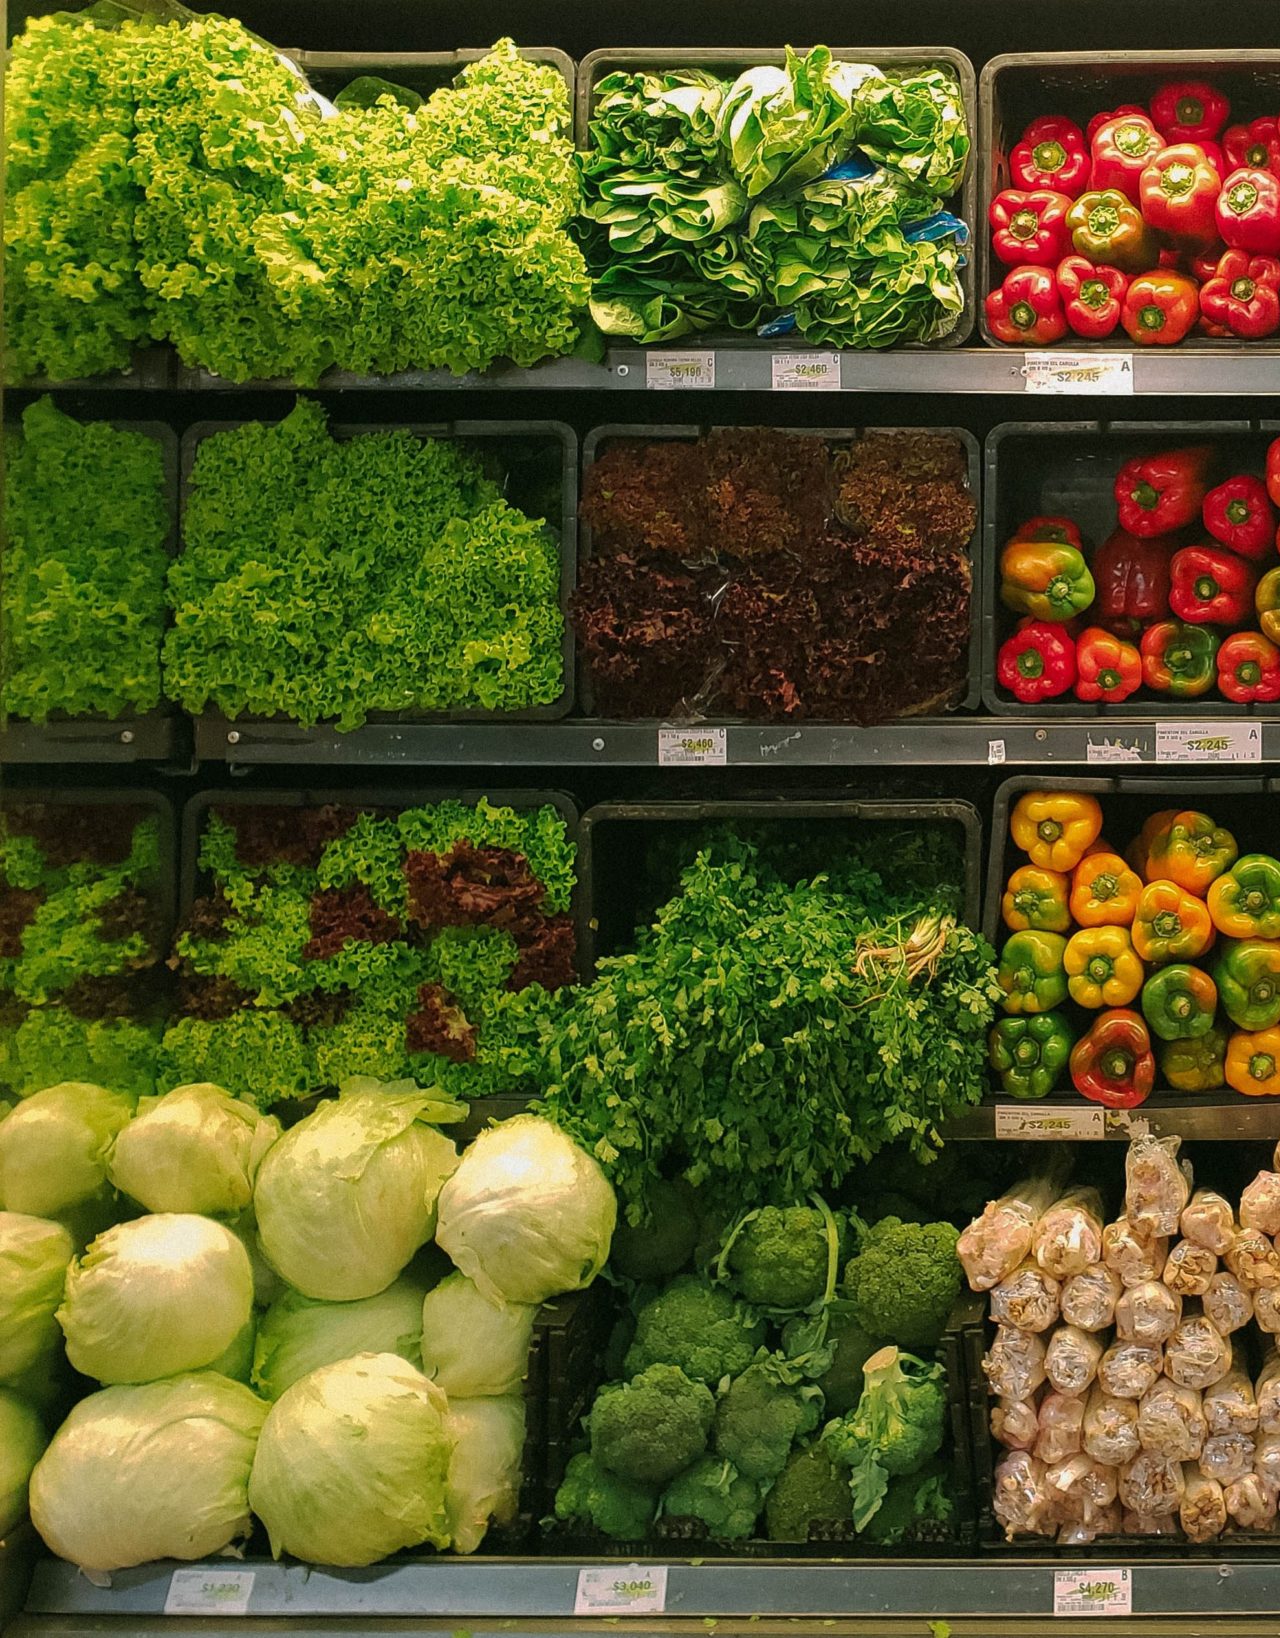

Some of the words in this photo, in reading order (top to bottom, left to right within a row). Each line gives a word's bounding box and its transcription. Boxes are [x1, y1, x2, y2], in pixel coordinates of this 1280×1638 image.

[707, 357, 713, 367] C
[833, 354, 839, 364] C
[795, 364, 827, 375] $2,460
[1121, 361, 1131, 372] A
[670, 367, 702, 378] $5,190
[1057, 372, 1099, 382] $2245
[719, 728, 725, 738] C
[1249, 729, 1258, 739] A
[681, 738, 713, 749] $2,460
[1187, 740, 1229, 751] $2,245
[1092, 1113, 1101, 1122] A
[1028, 1120, 1071, 1130] $2,245
[1121, 1570, 1128, 1581] B
[1079, 1582, 1115, 1596] $4,270
